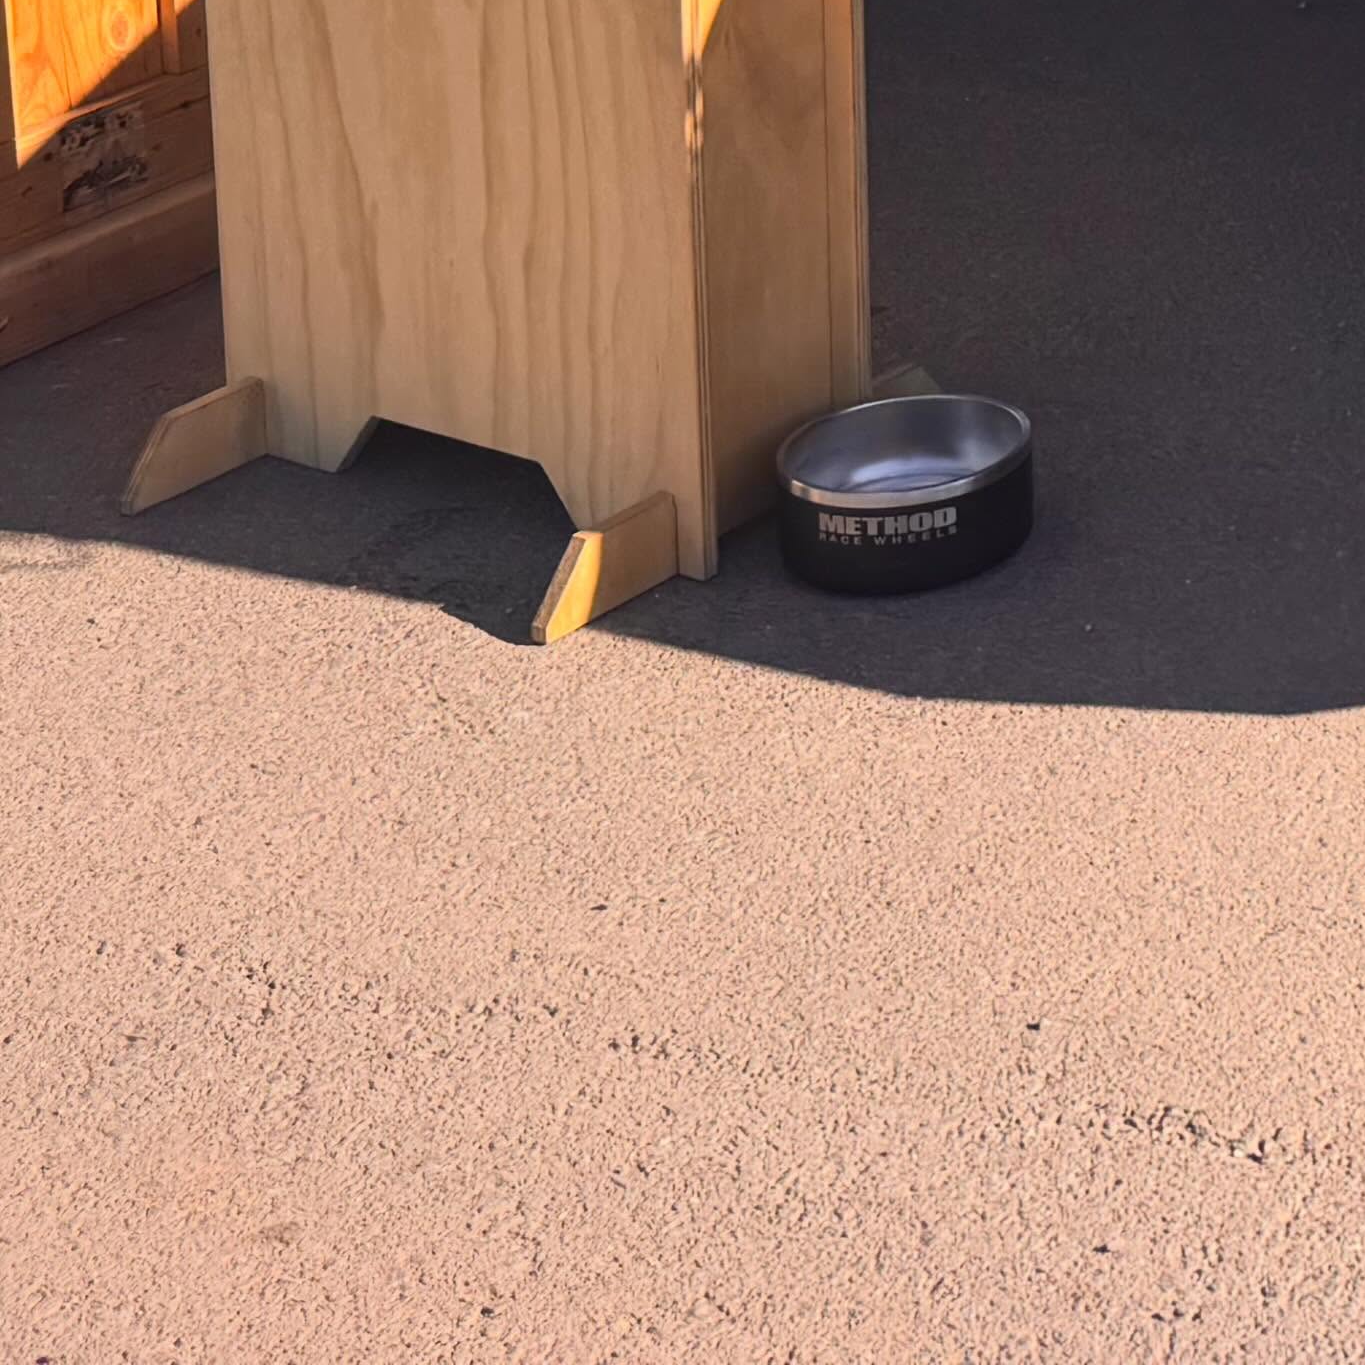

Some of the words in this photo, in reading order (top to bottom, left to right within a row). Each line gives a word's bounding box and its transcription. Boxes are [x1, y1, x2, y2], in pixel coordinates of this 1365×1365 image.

[818, 506, 958, 536] METHOD
[818, 531, 863, 546] RACE
[873, 524, 958, 547] WHEELS
